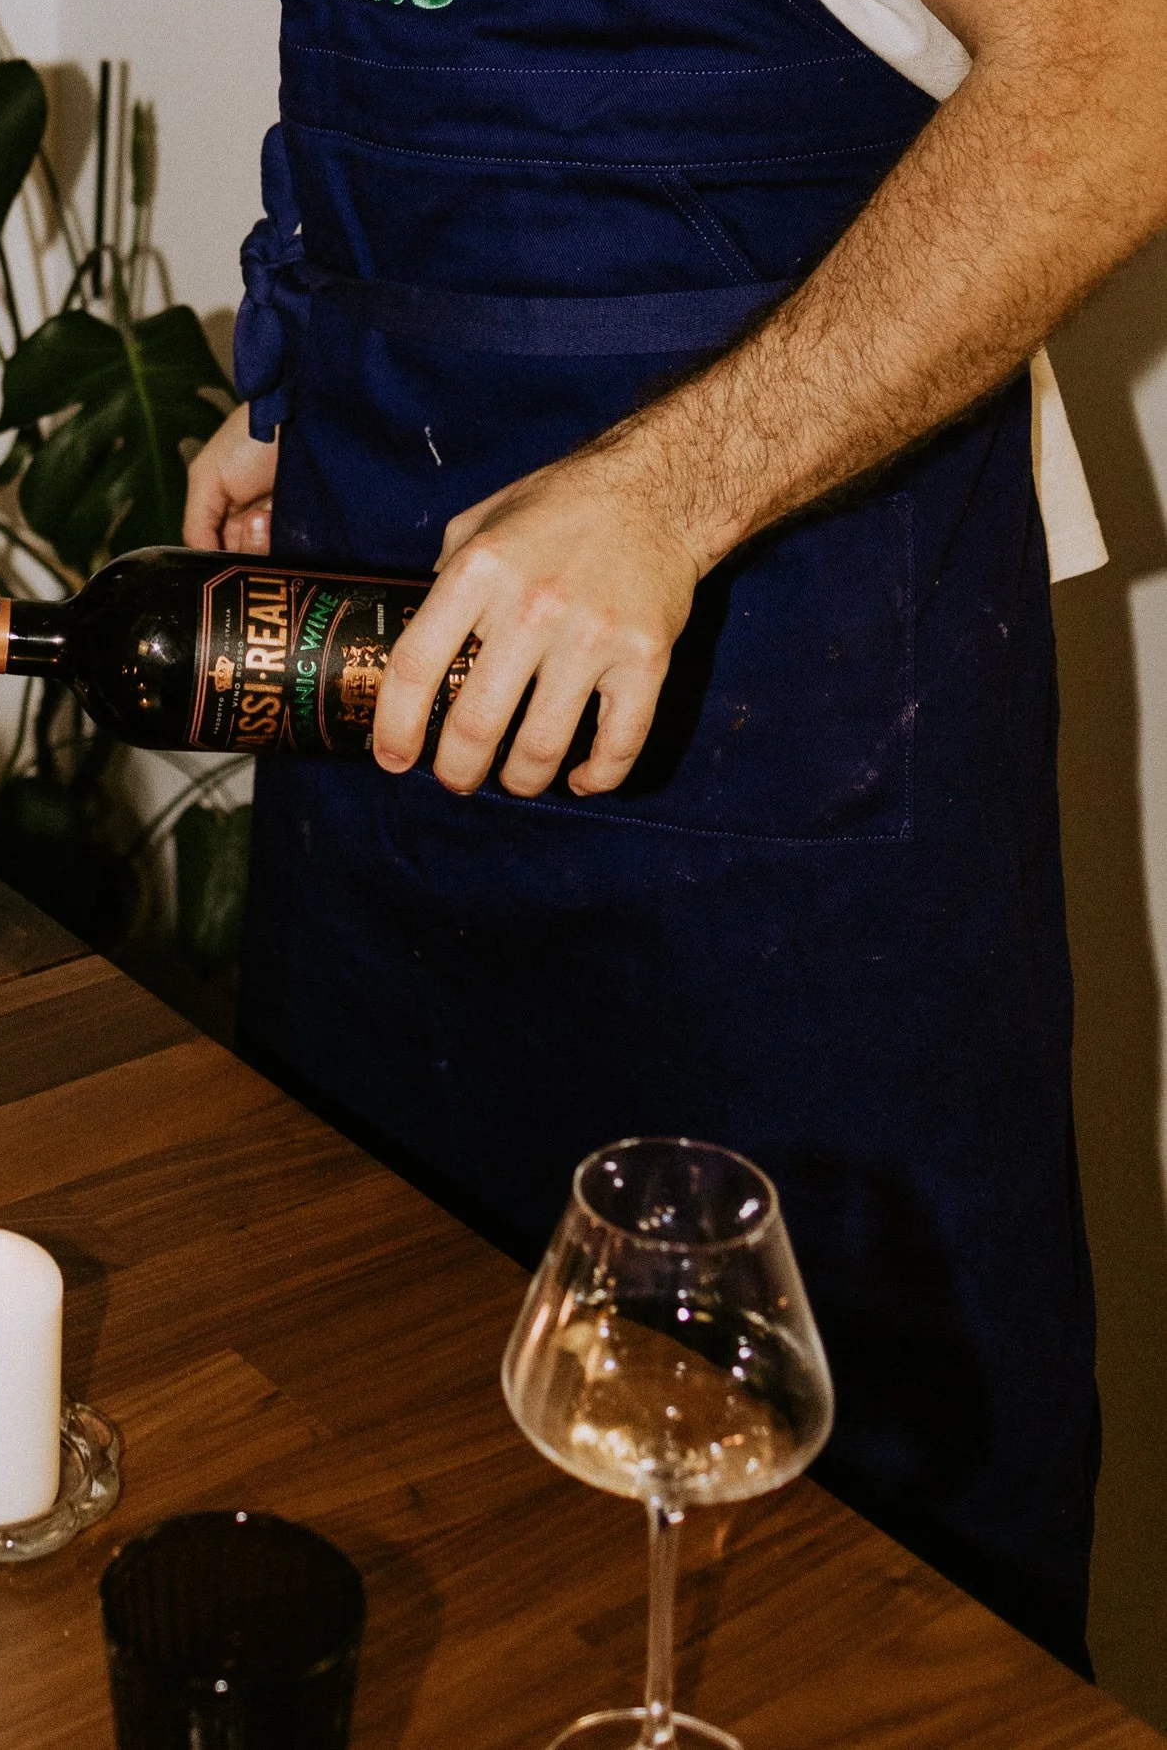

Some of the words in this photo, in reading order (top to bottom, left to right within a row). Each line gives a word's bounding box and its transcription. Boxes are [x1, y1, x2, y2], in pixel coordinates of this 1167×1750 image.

[299, 591, 339, 651] WINE
[236, 641, 244, 678] ROSSO
[232, 683, 242, 708] VINO
